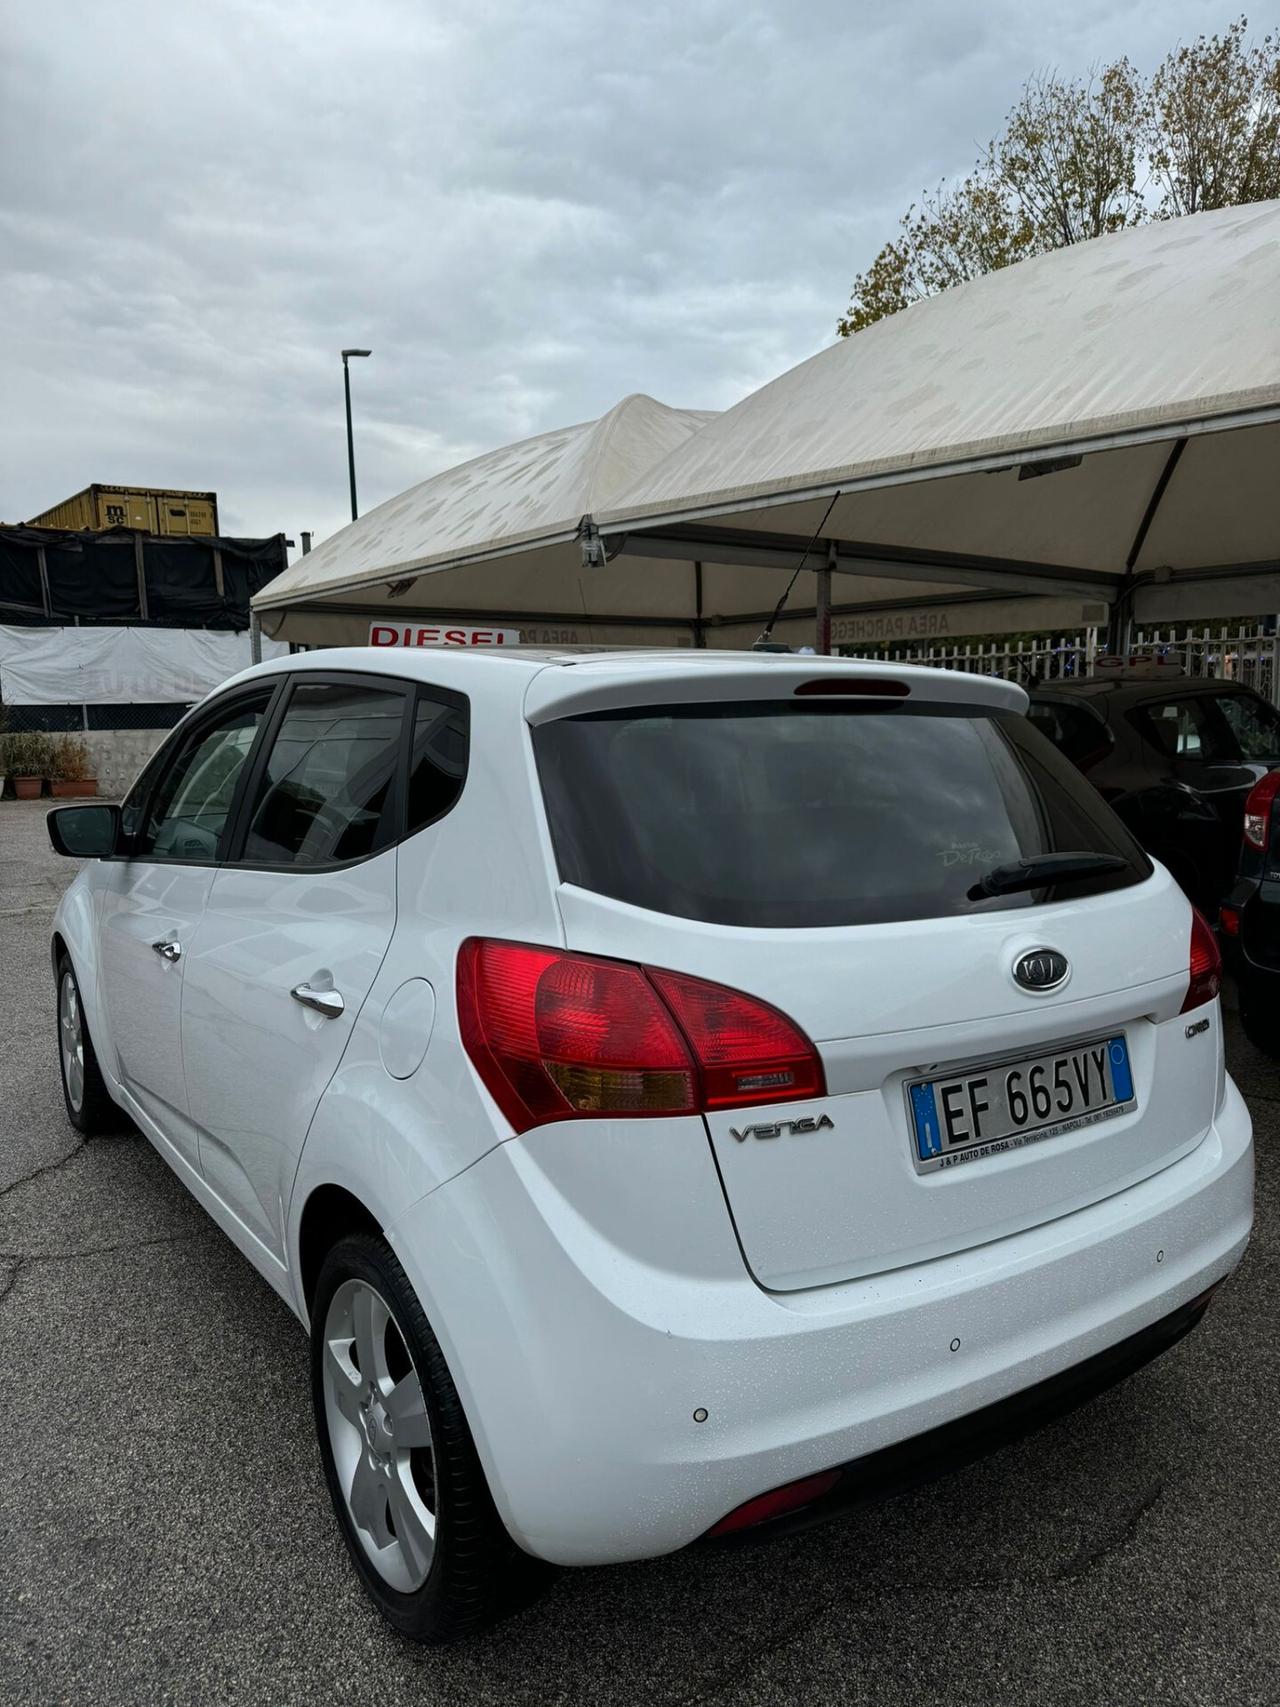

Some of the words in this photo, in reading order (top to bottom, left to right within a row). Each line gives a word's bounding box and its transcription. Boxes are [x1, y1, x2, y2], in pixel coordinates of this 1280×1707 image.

[1095, 655, 1179, 668] GPL
[940, 1077, 989, 1145] EF
[1005, 1047, 1108, 1127] 665VY
[940, 1157, 945, 1168] J
[945, 1156, 952, 1166] &
[953, 1154, 958, 1164] P
[960, 1148, 979, 1161] AUTO
[980, 1146, 990, 1156] DE
[991, 1140, 1010, 1153] ROSA
